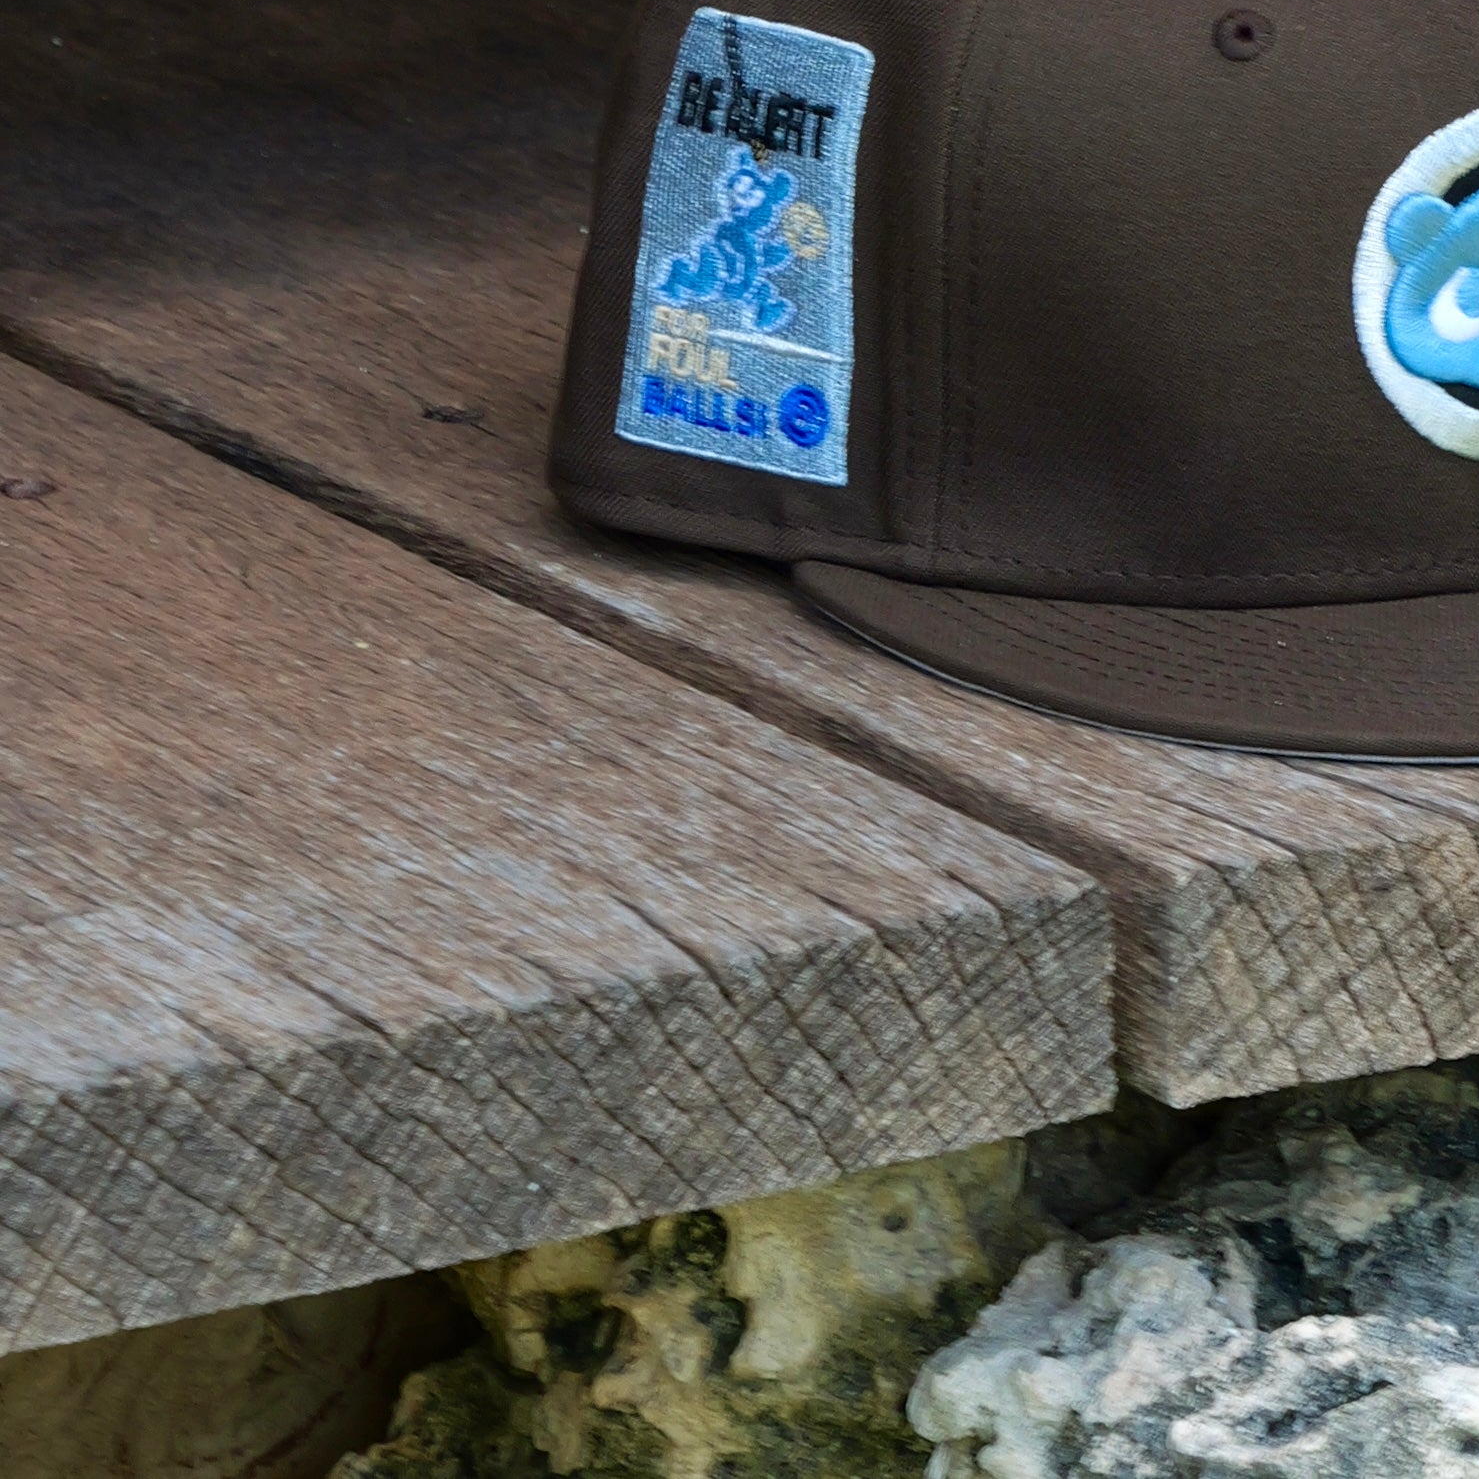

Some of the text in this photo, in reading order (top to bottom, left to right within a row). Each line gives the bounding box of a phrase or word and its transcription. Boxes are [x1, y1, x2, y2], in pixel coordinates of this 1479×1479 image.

[677, 70, 724, 134] BE
[652, 304, 710, 336] FOR
[647, 331, 739, 390] FOUL
